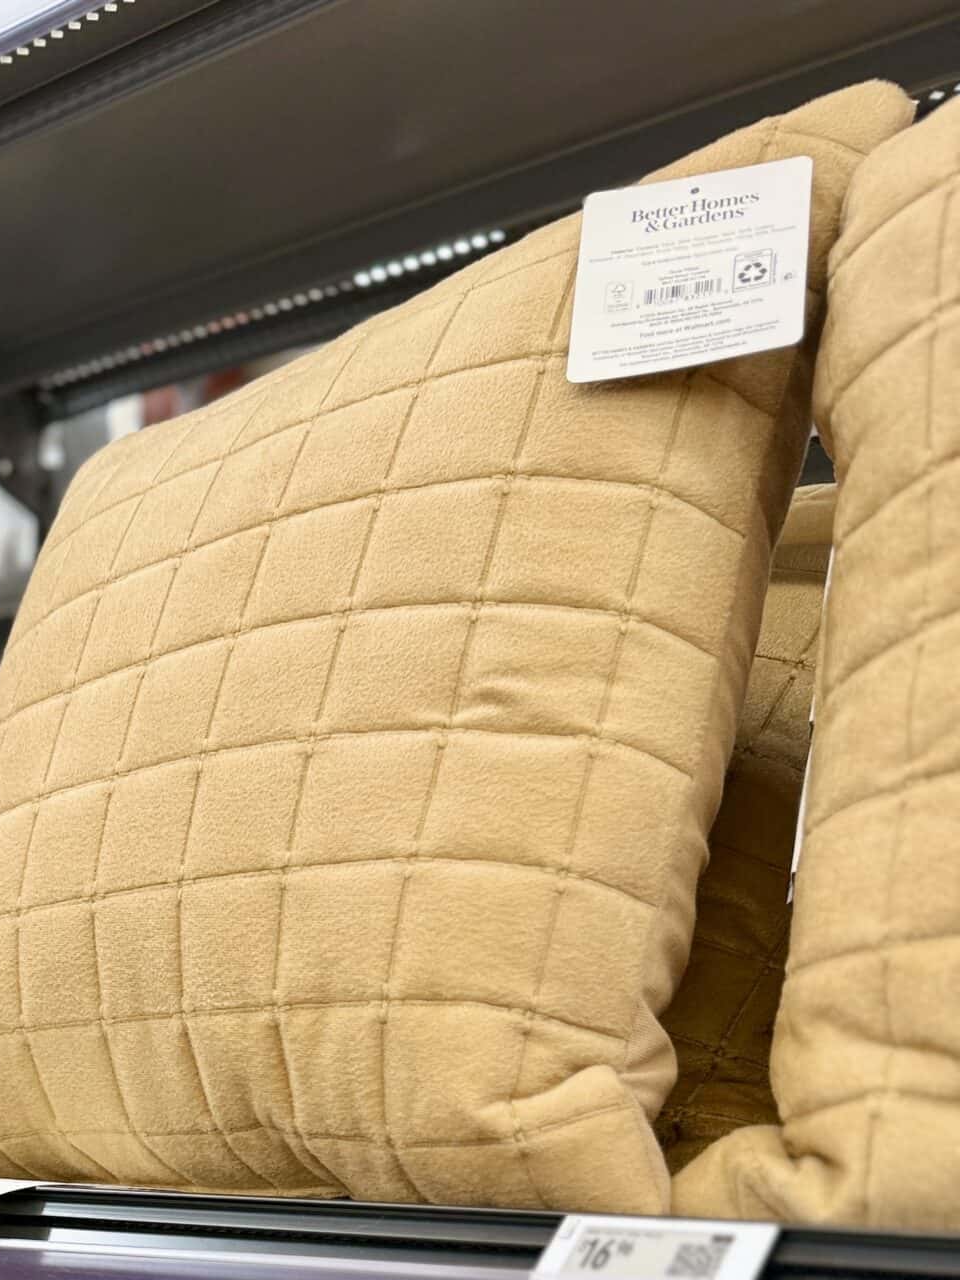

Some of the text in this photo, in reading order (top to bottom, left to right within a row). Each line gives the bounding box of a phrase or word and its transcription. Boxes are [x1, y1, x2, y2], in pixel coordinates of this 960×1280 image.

[632, 192, 760, 223] Better Homes
[645, 209, 745, 233] & Gardens
